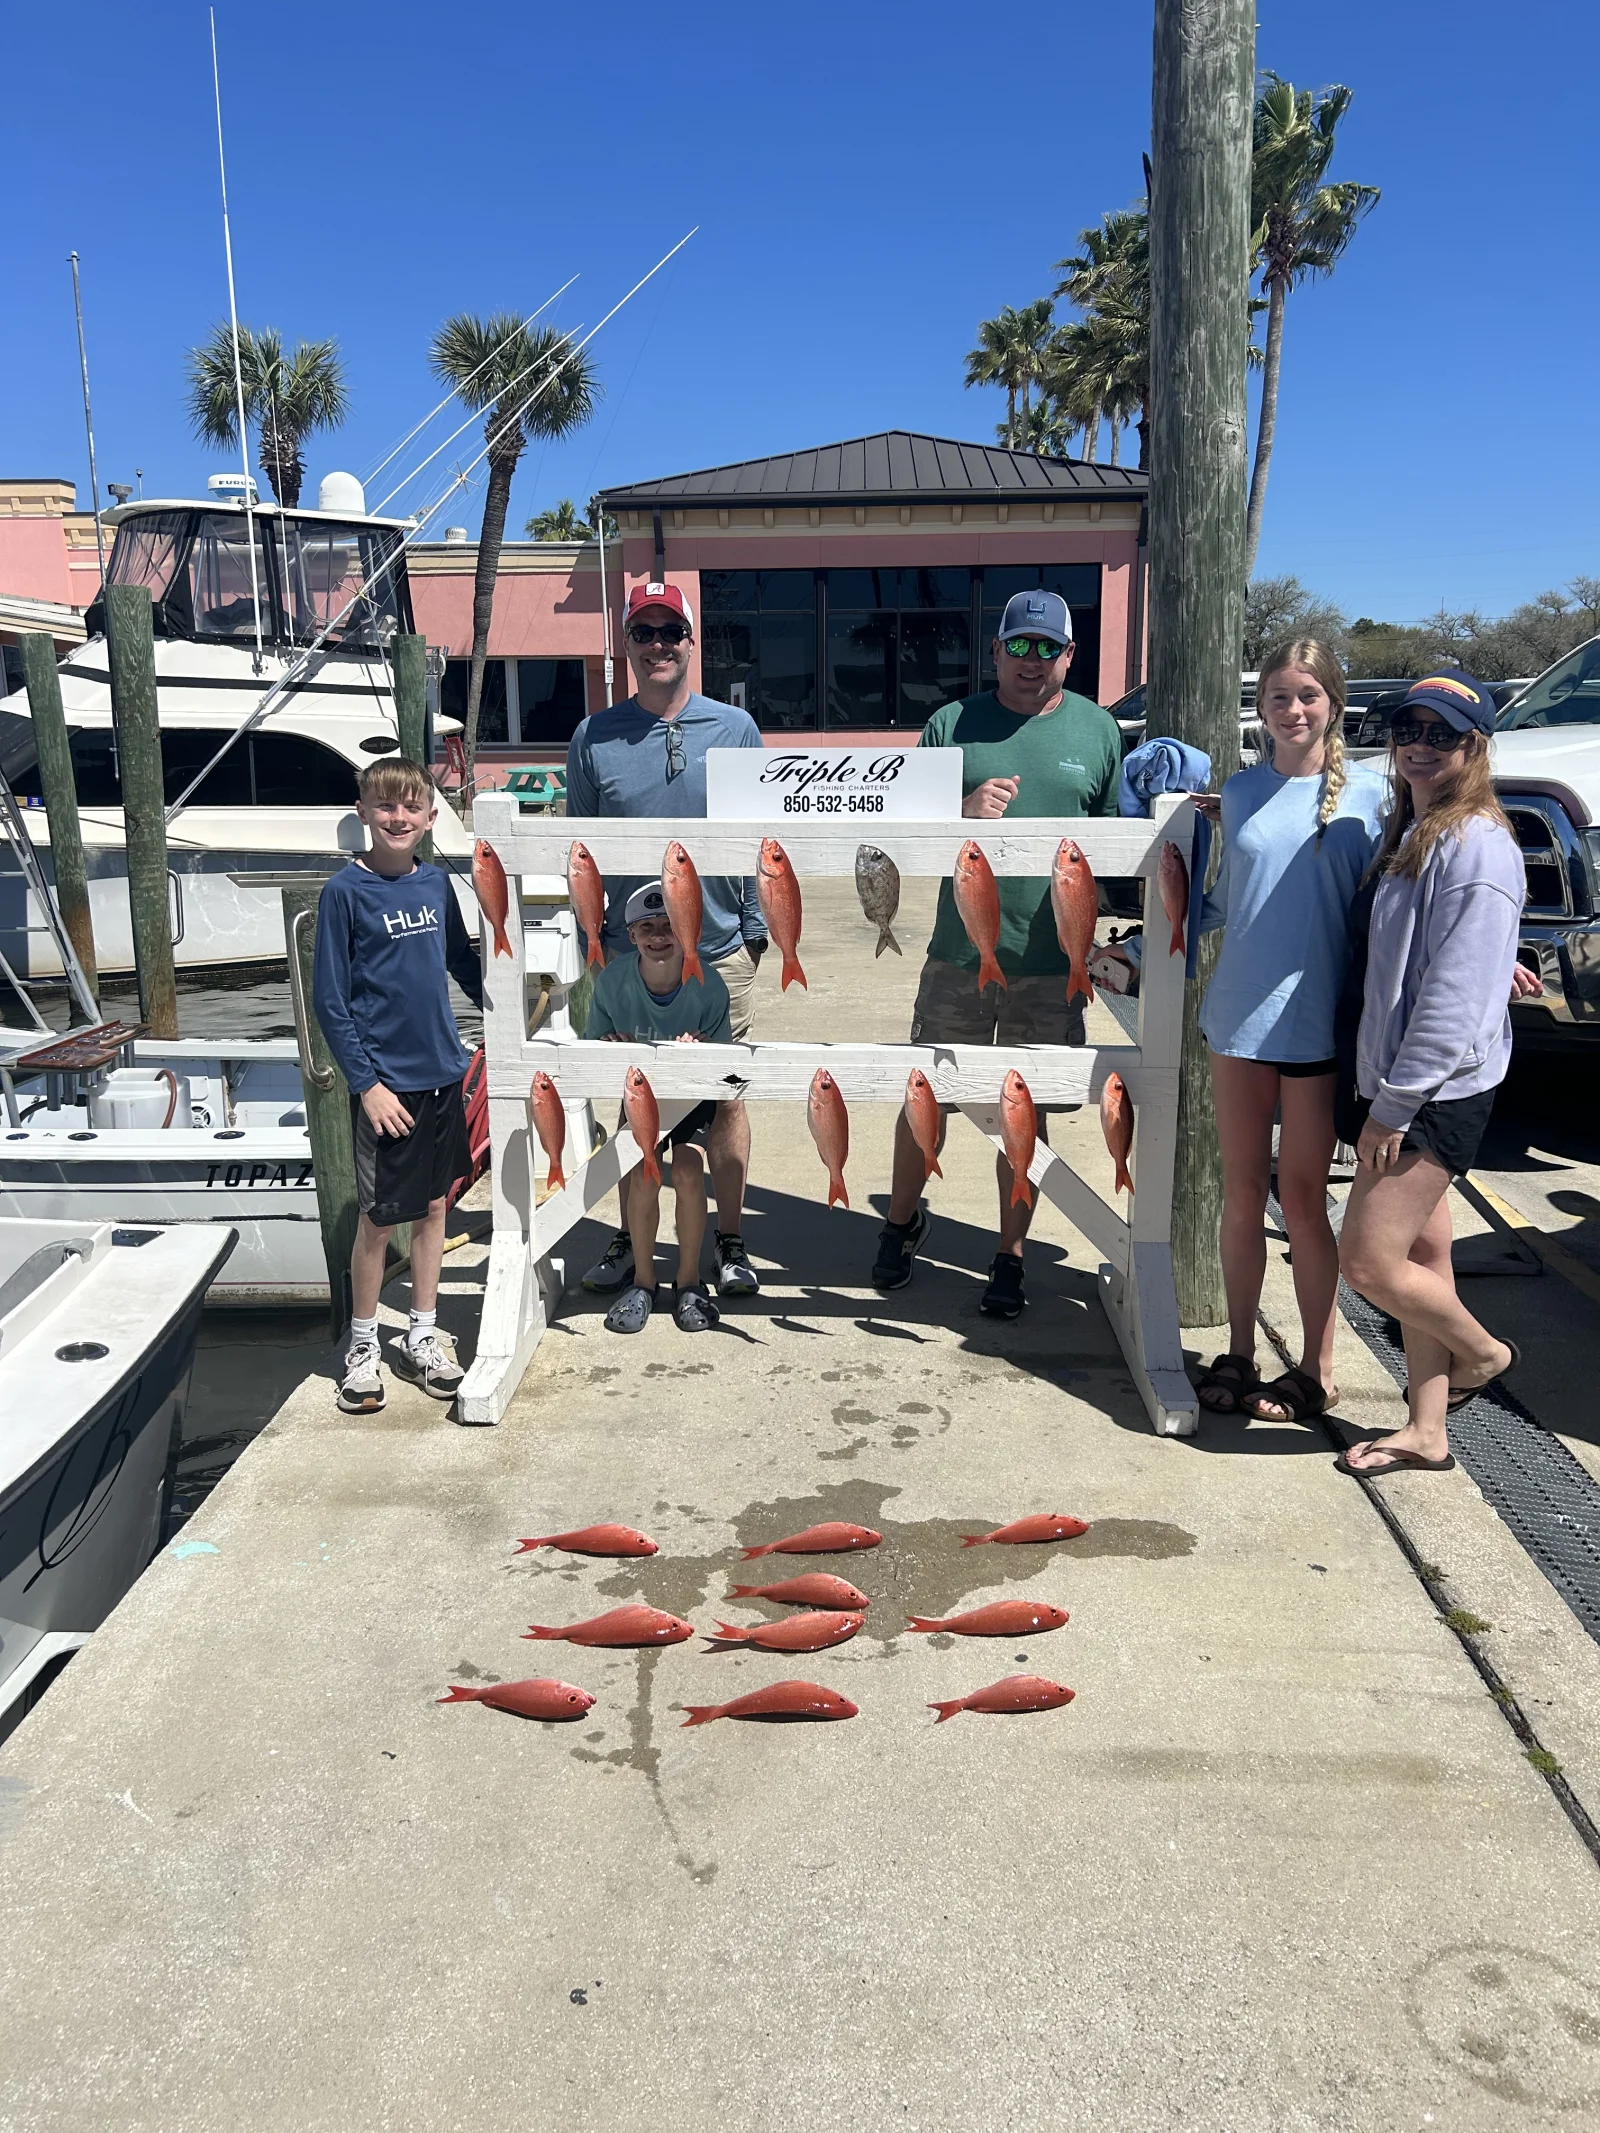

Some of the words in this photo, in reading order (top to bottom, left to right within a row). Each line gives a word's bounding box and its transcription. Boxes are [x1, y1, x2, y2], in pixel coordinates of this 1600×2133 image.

[759, 755, 859, 794] Triple
[863, 753, 909, 783] B
[783, 795, 884, 813] 850-532-5458
[206, 1163, 314, 1188] TOPAZ
